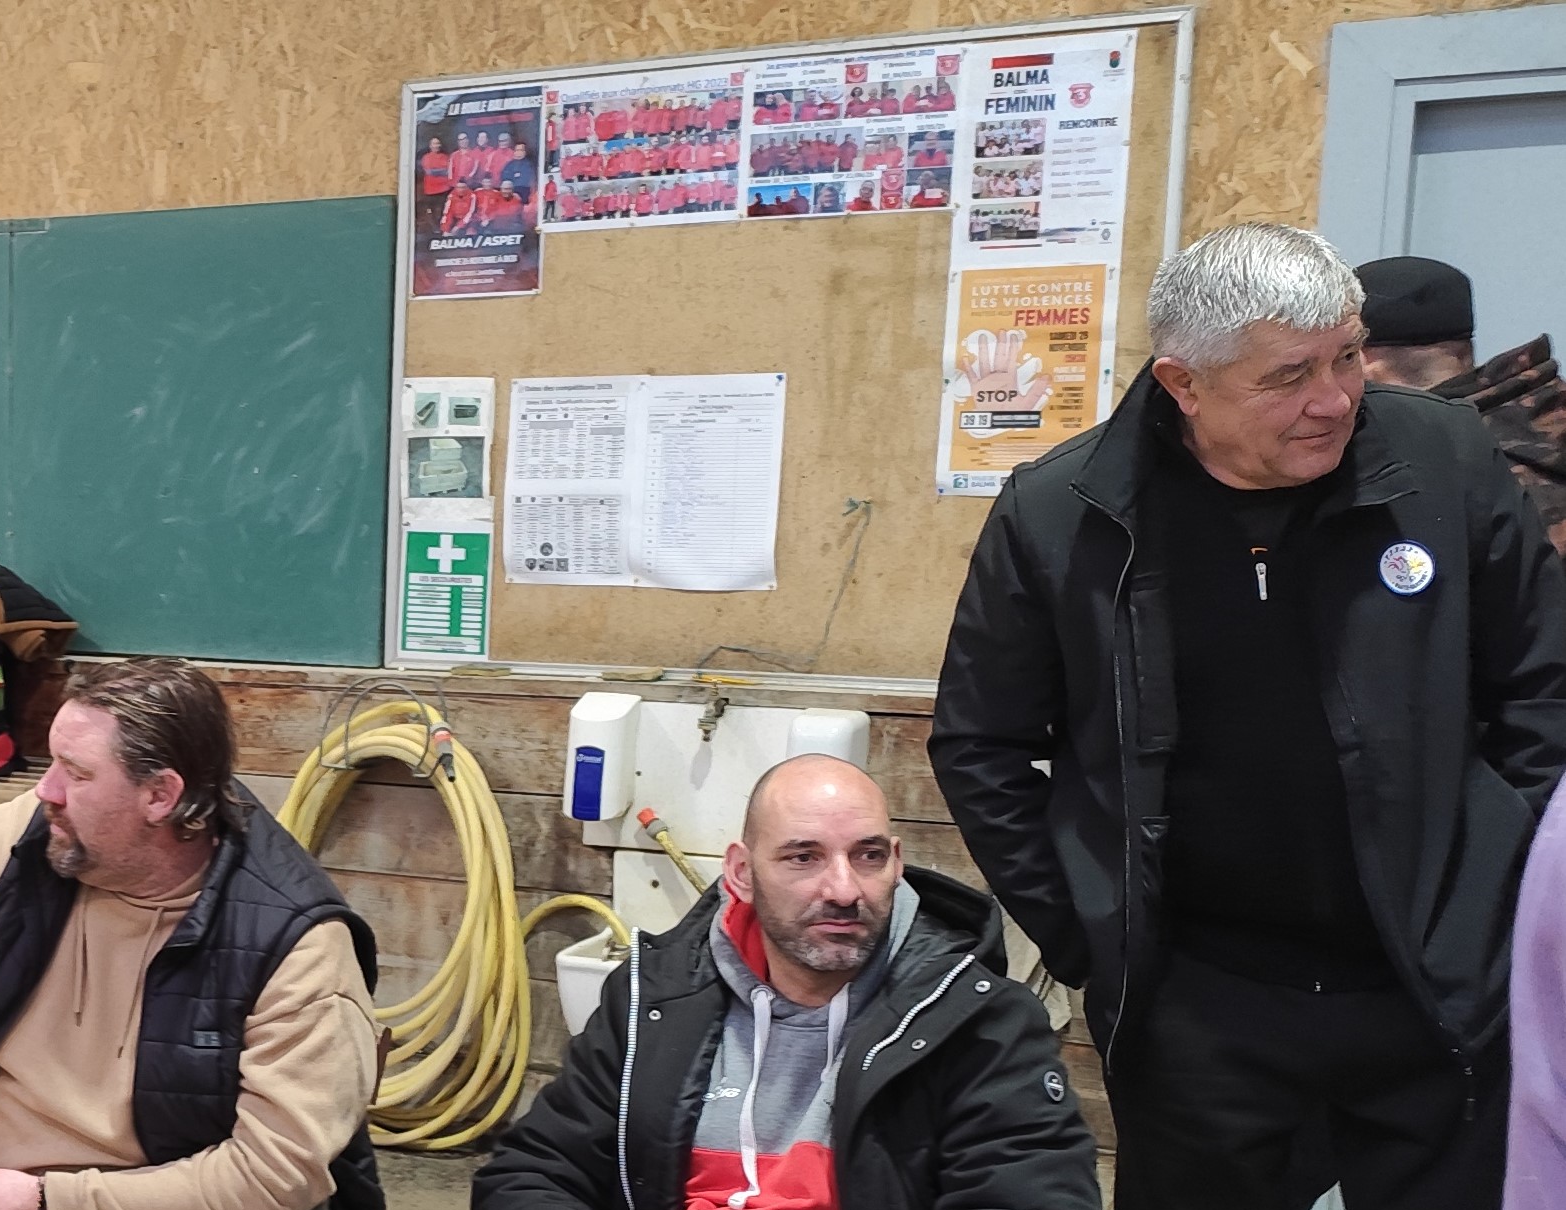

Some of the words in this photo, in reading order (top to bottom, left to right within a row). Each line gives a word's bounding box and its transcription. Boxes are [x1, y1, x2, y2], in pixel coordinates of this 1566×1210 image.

[994, 69, 1050, 88] BALMA
[984, 93, 1056, 116] FEMININ
[1058, 117, 1119, 130] RENCONTRE
[430, 237, 474, 250] BALMA
[482, 234, 524, 247] ASPET
[971, 284, 1021, 297] LUTTE
[1026, 281, 1094, 295] CONTRE
[971, 297, 997, 309] LES
[1003, 294, 1093, 308] VIOLENCES
[1013, 307, 1091, 327] FEMMES
[976, 389, 1018, 403] STOP
